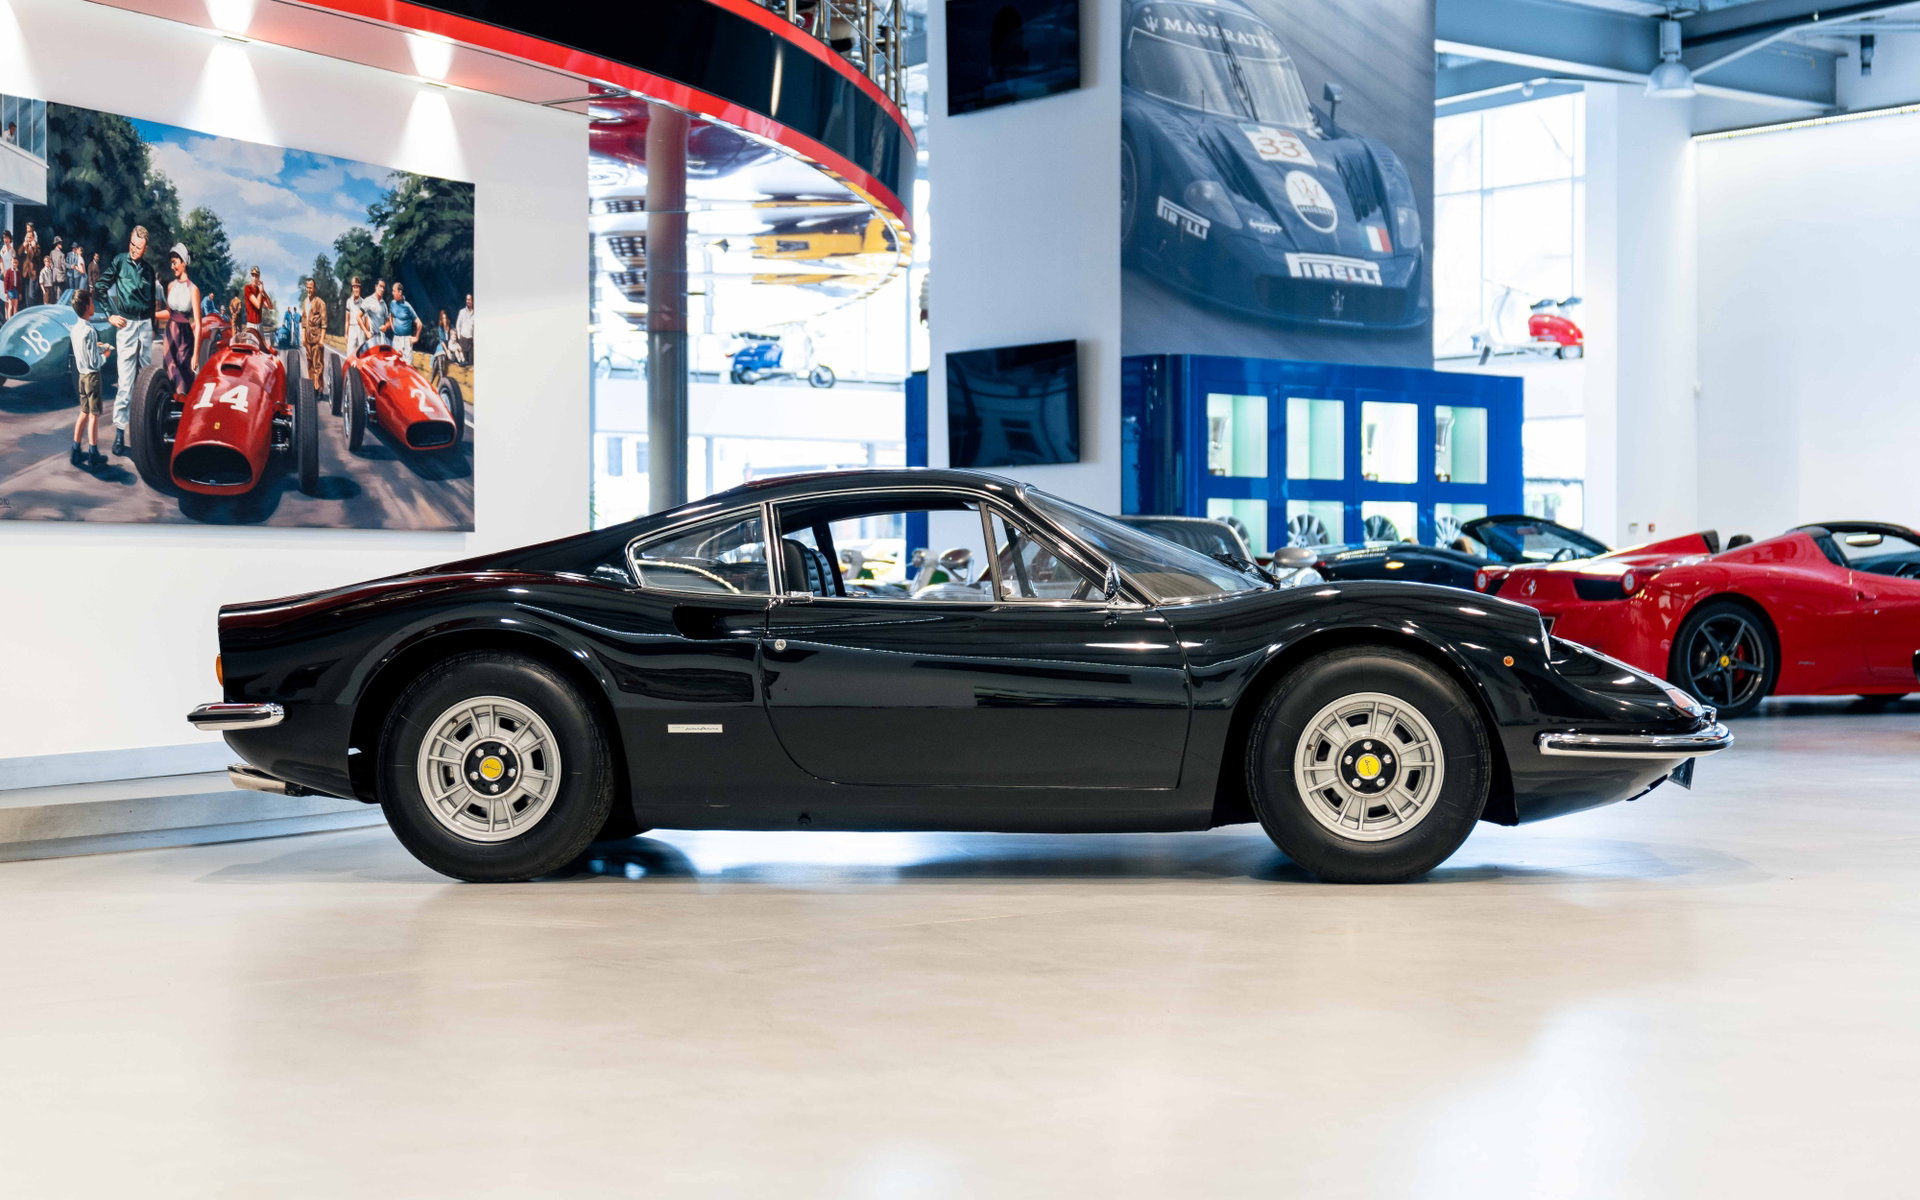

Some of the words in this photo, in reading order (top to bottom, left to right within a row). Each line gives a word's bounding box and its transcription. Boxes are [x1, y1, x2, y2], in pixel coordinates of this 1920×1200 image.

[1163, 17, 1269, 50] MASERATI
[1257, 137, 1301, 158] 33
[1157, 195, 1211, 240] PIRLLI
[1285, 252, 1383, 286] PIRELLI
[20, 329, 51, 355] 18
[193, 382, 248, 413] 14
[410, 388, 434, 412] 2
